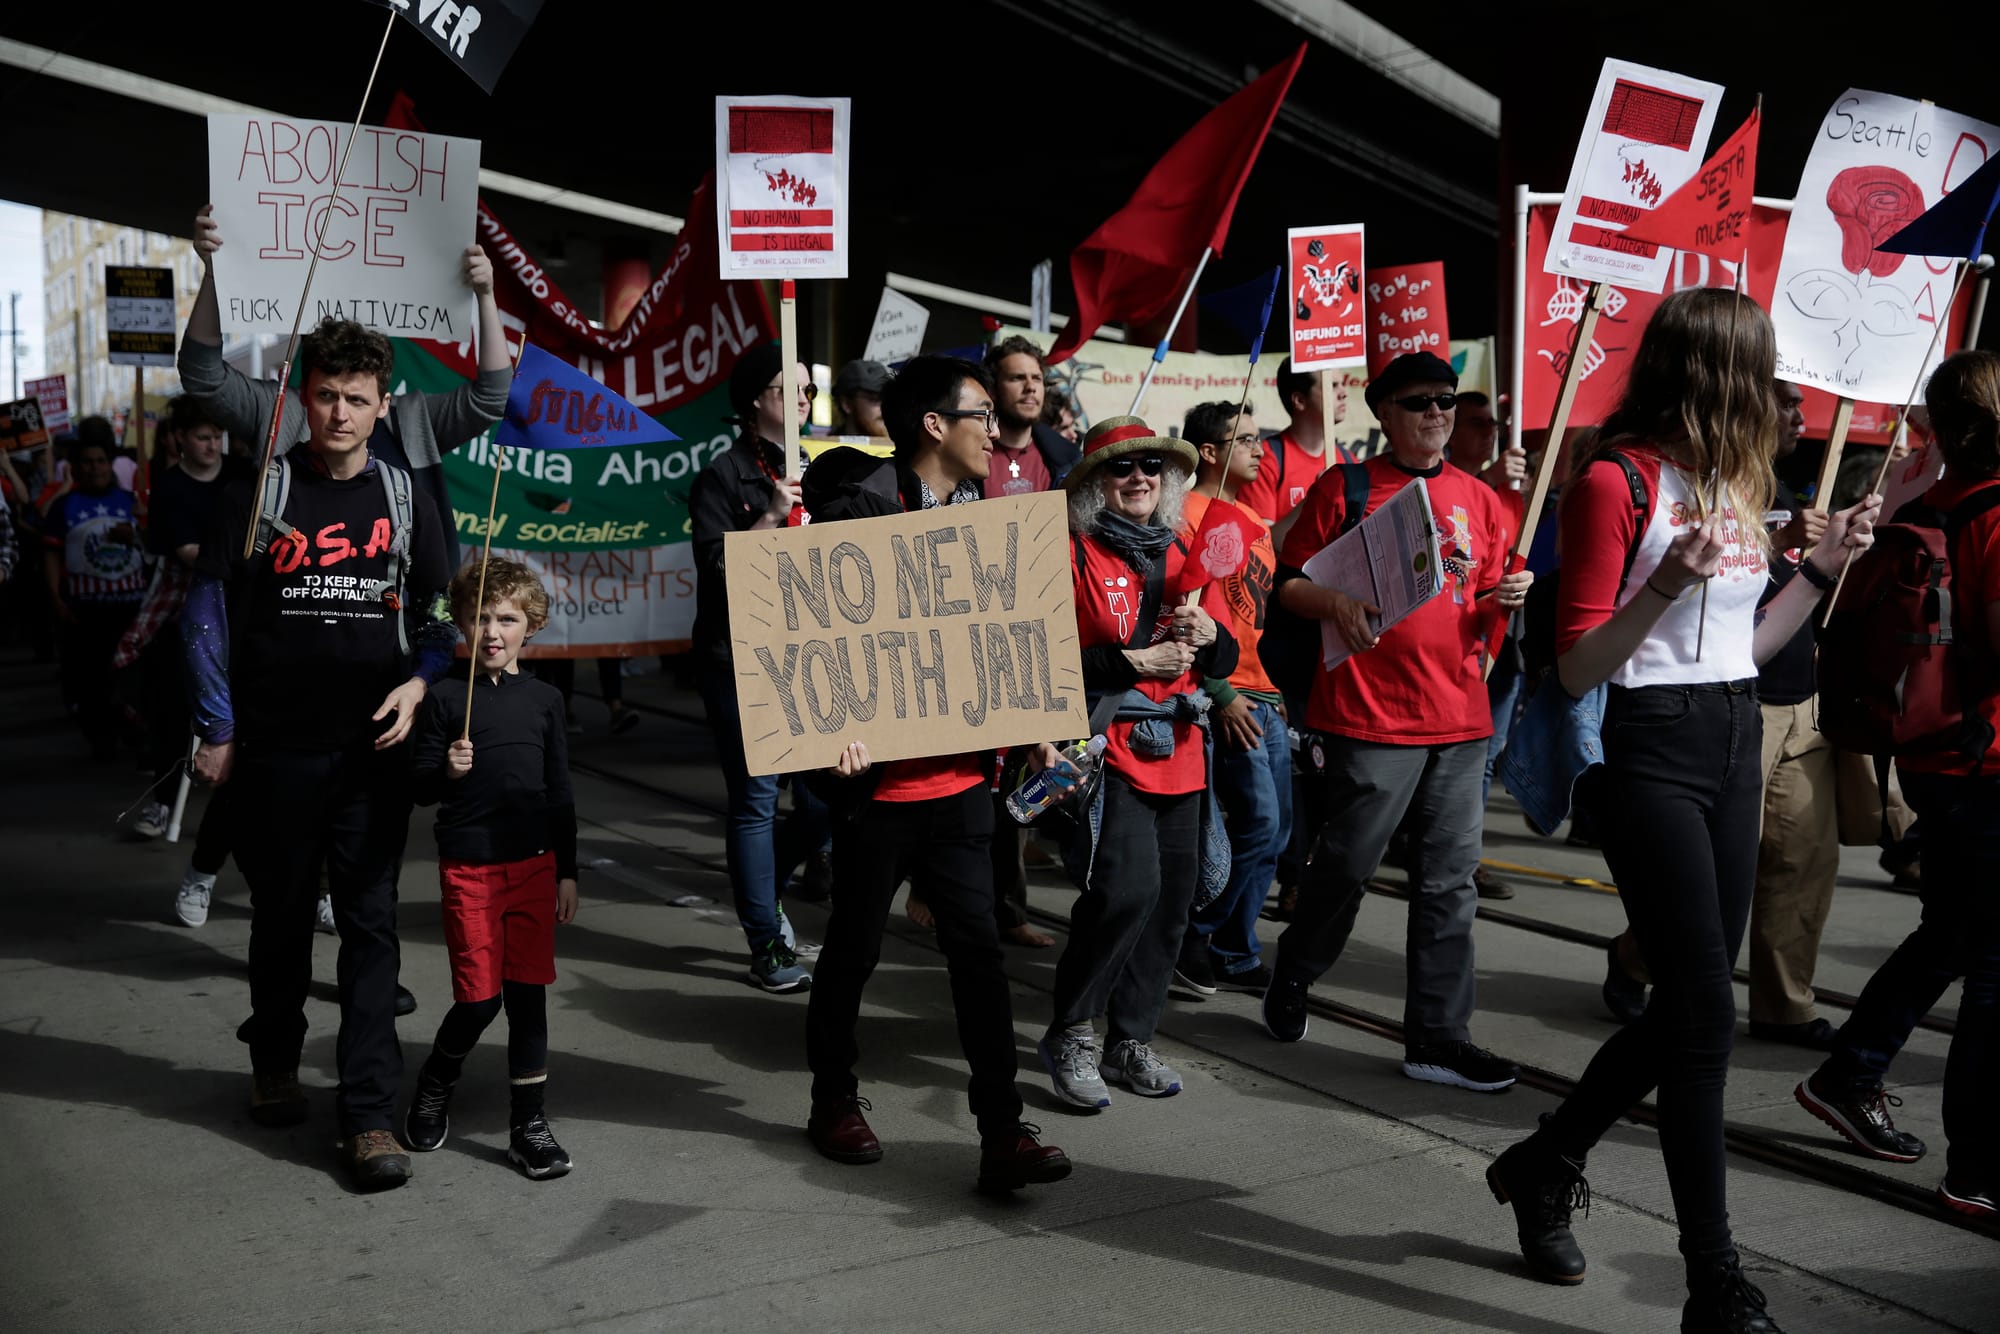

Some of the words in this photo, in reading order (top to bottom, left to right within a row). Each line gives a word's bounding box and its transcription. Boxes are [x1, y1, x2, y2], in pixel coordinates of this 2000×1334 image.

[389, 0, 482, 59] VER
[1827, 97, 1932, 158] Seattle
[237, 120, 449, 202] ABOLISH
[743, 211, 761, 226] NO
[764, 210, 801, 226] HUMAN
[1588, 198, 1606, 217] NO
[1607, 206, 1641, 223] HUMAN
[257, 191, 408, 268] ICE
[1595, 229, 1613, 248] IS
[762, 234, 778, 251] IS
[783, 234, 826, 251] ILLEGAL
[1368, 273, 1432, 304] Power
[229, 297, 283, 323] FUCK
[317, 298, 453, 335] NATIVISM
[1378, 311, 1396, 328] to
[1400, 305, 1428, 324] the
[1294, 325, 1342, 343] DEFUND
[1343, 323, 1362, 337] ICE
[1378, 328, 1440, 353] People
[303, 575, 321, 587] TO
[324, 575, 357, 588] KEEP
[359, 577, 381, 590] KID
[551, 567, 695, 607] RIGHTS
[776, 541, 876, 632] NO
[891, 521, 1020, 620] NEW
[281, 587, 311, 599] OFF
[311, 588, 383, 602] CAPITALI.
[753, 629, 949, 737] YOUTH
[962, 618, 1068, 728] JAIL
[1023, 778, 1046, 801] smart
